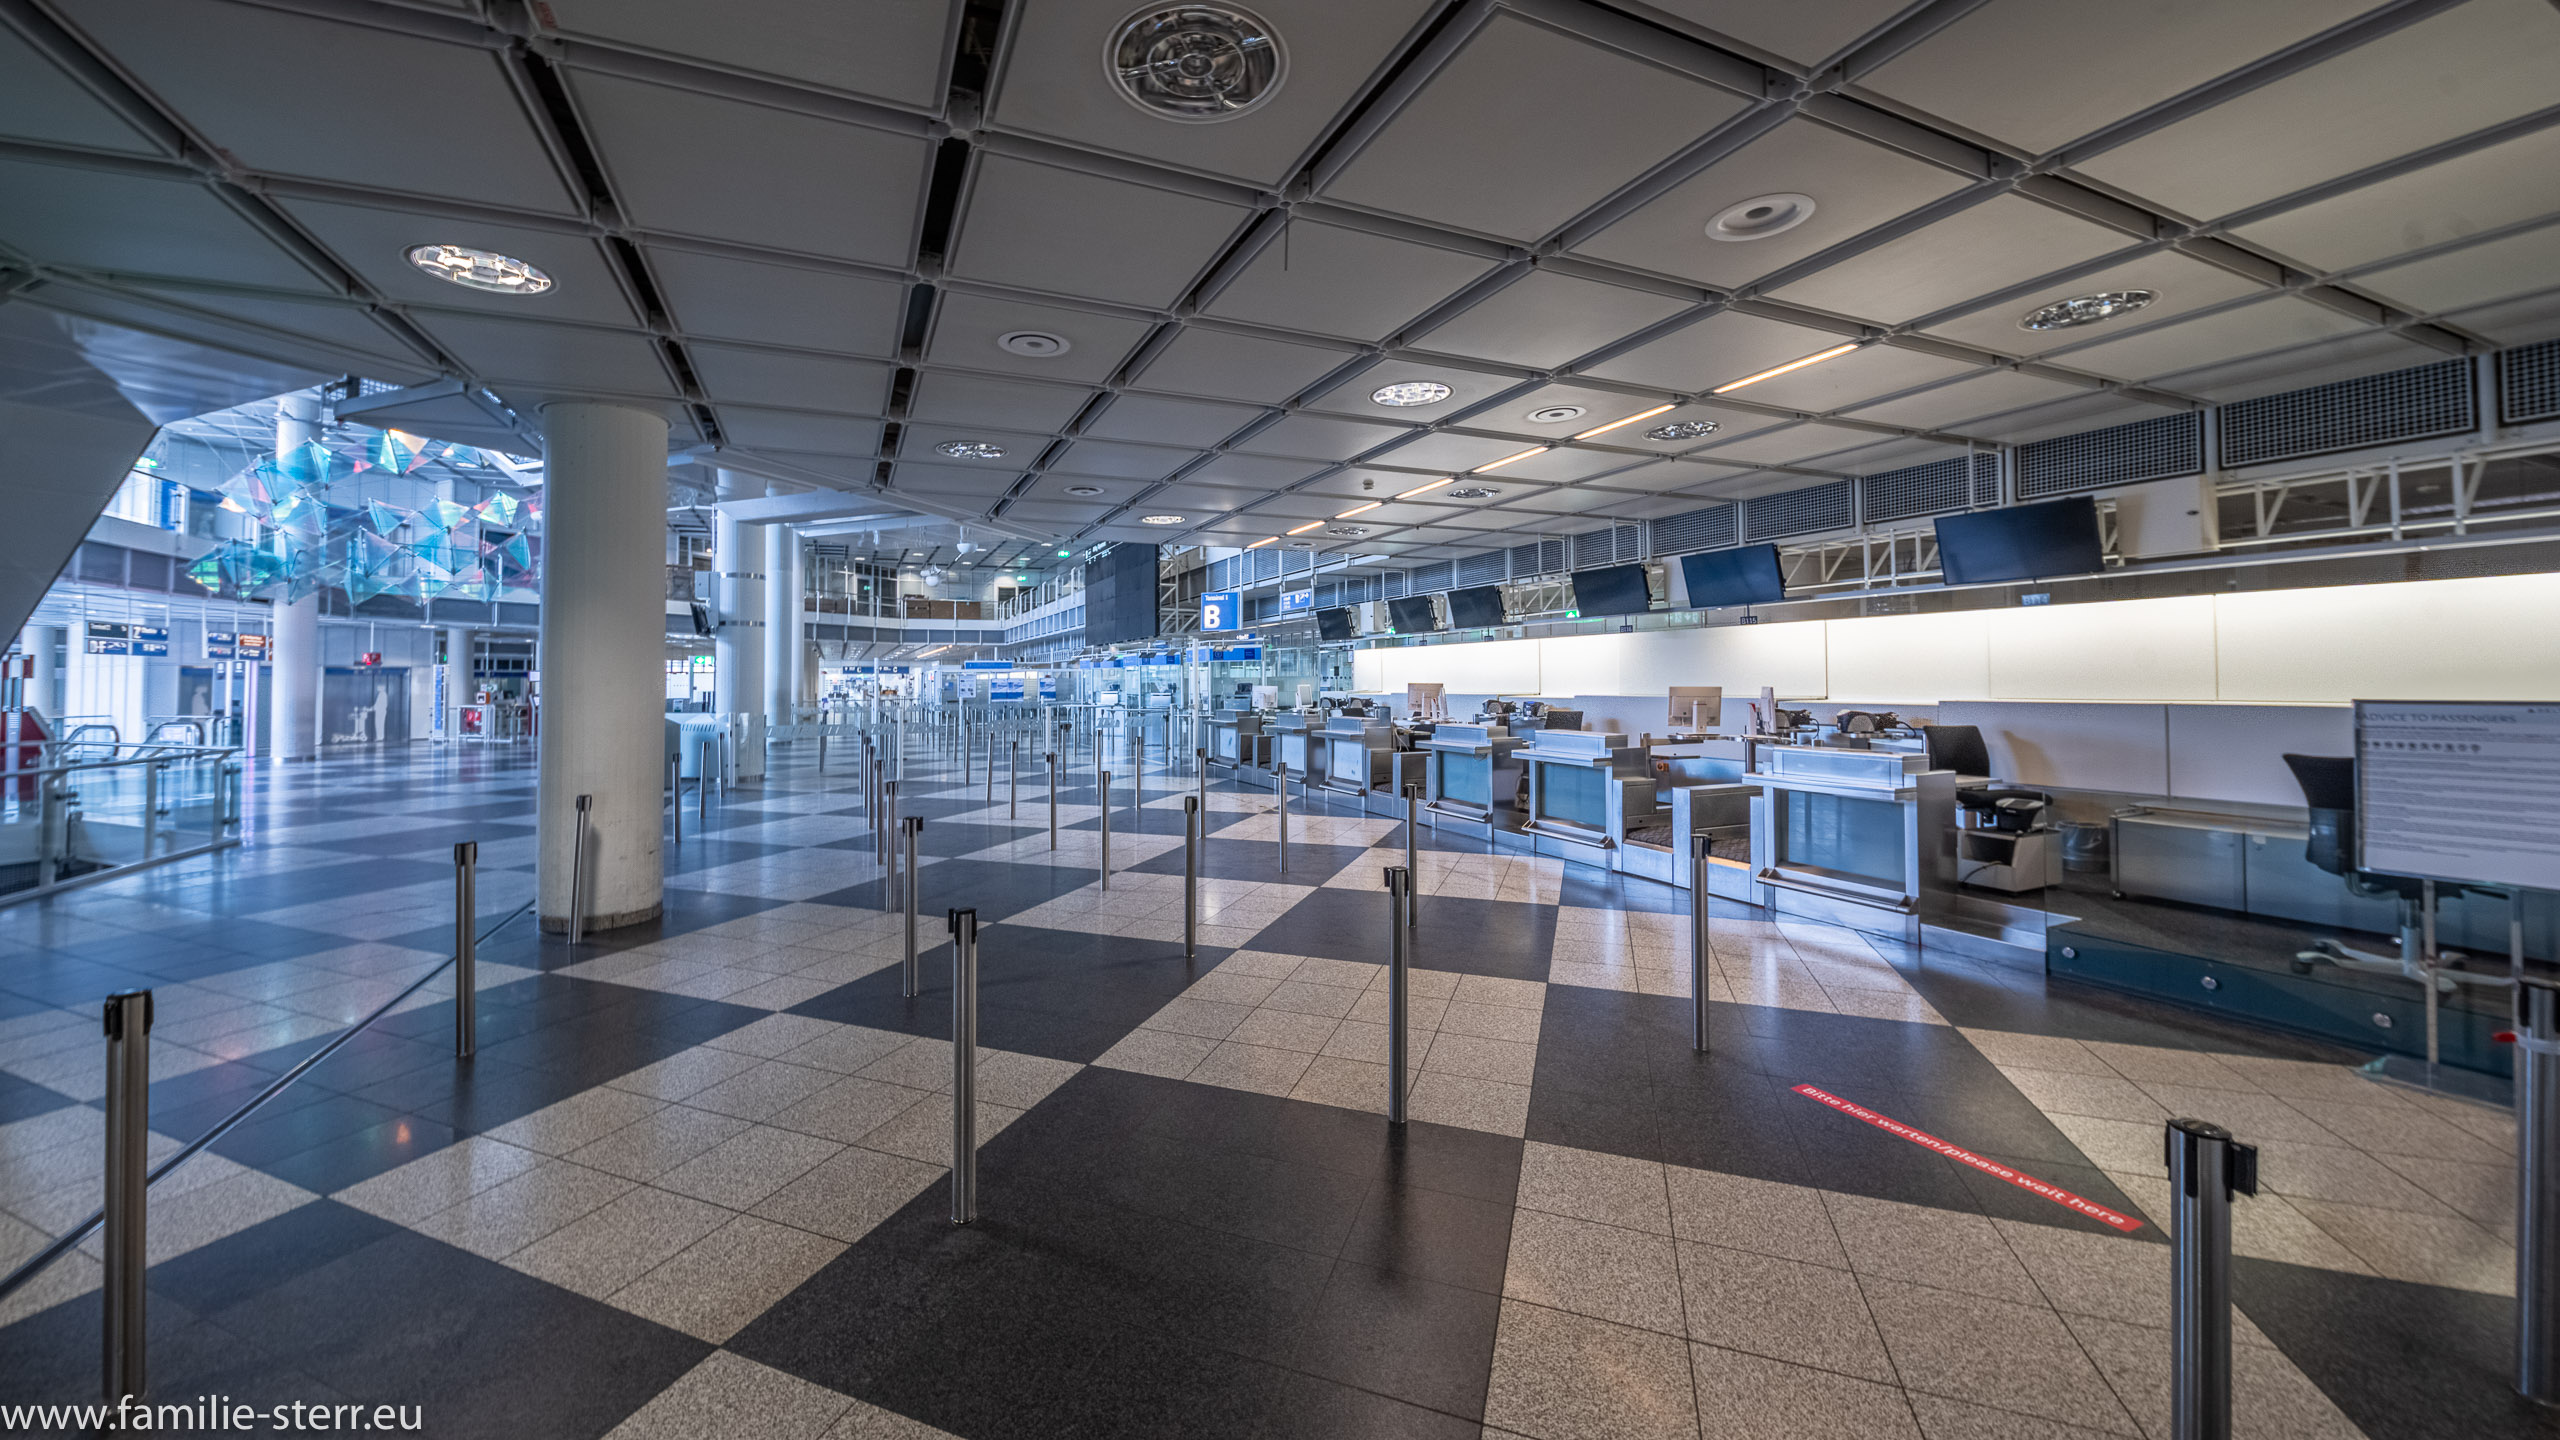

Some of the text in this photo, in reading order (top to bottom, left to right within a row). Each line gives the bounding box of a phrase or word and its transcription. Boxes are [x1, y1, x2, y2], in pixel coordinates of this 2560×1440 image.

[1204, 604, 1220, 629] B
[2363, 712, 2517, 723] ADVICE TO PASSENGERS
[1802, 1087, 2125, 1225] Bitte hier warten/please wait here
